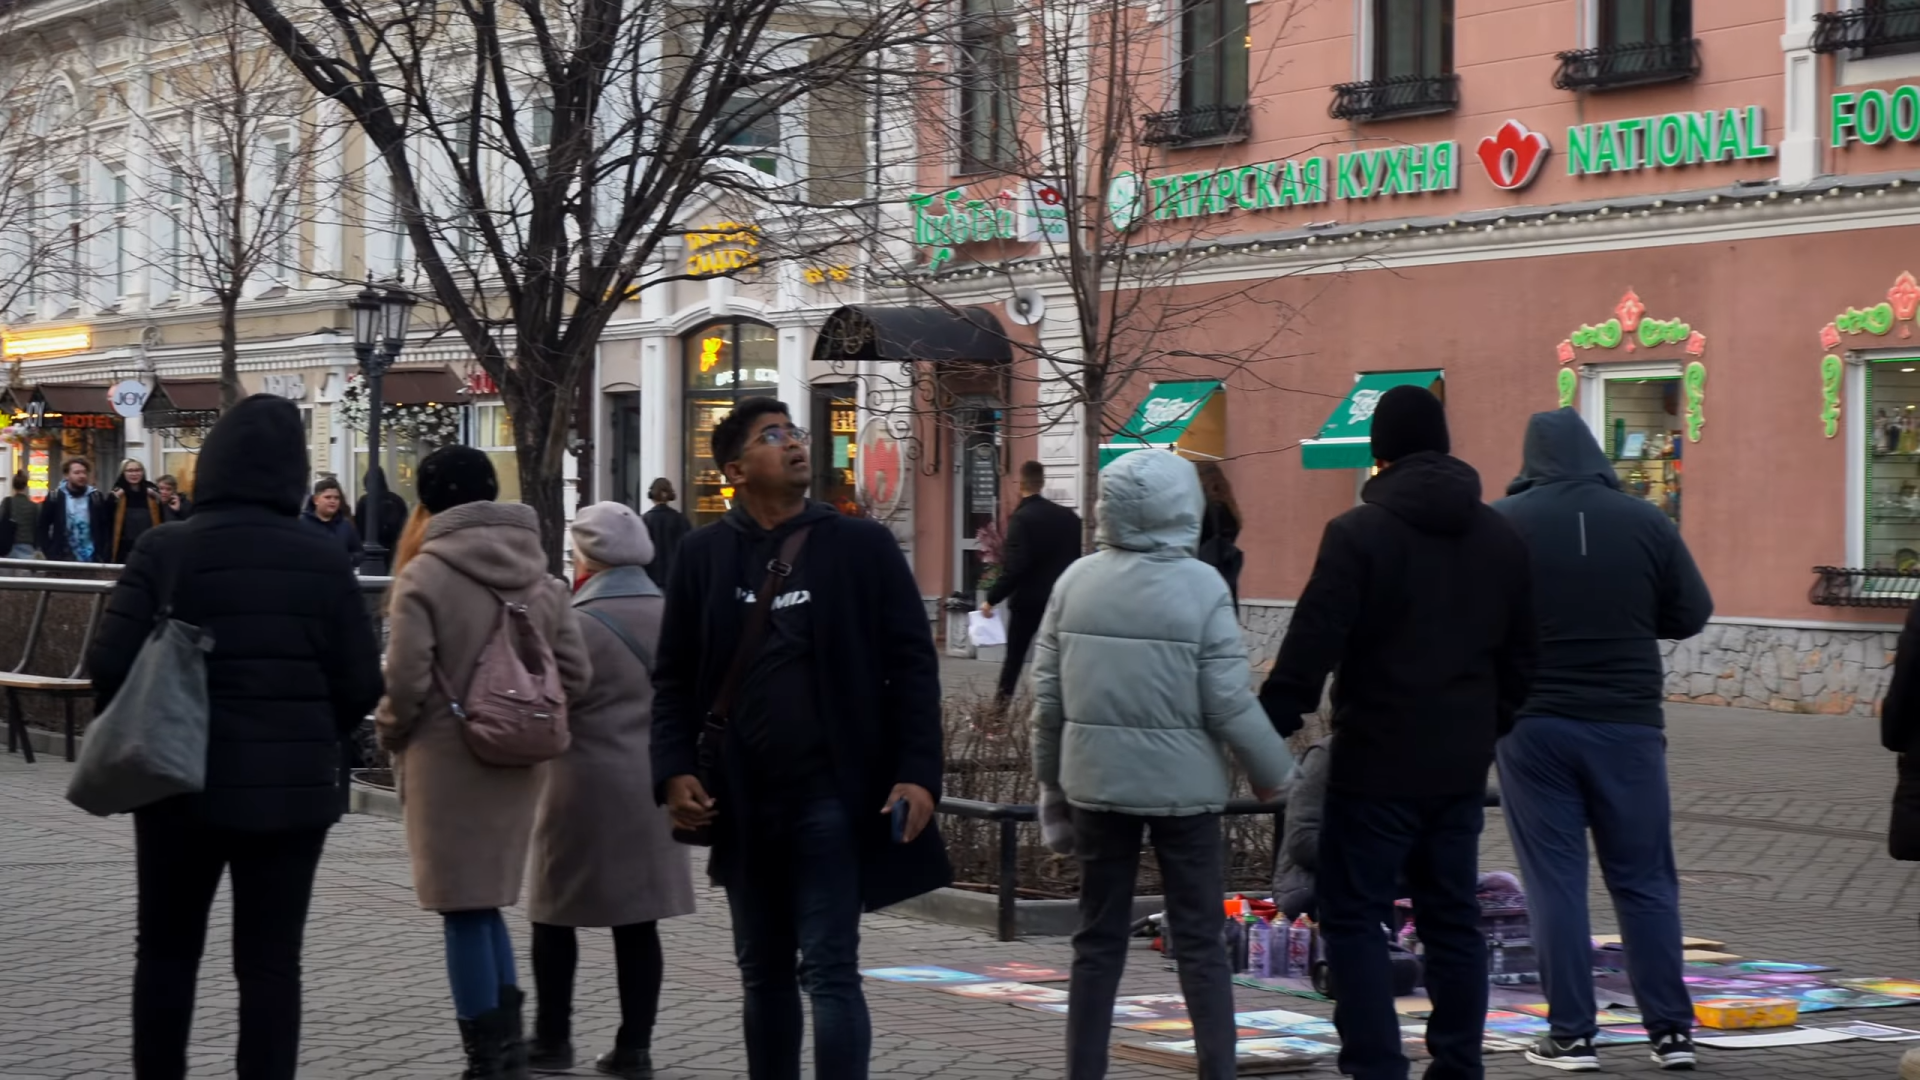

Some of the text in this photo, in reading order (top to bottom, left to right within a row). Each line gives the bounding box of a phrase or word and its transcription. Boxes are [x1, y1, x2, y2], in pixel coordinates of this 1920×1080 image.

[1566, 85, 1920, 176] NATIONAL FOO
[1151, 156, 1325, 220] ТАТАРСКАЯ
[1336, 141, 1455, 200] КУХНЯ
[62, 414, 114, 429] HOTEL
[114, 391, 147, 406] JOY
